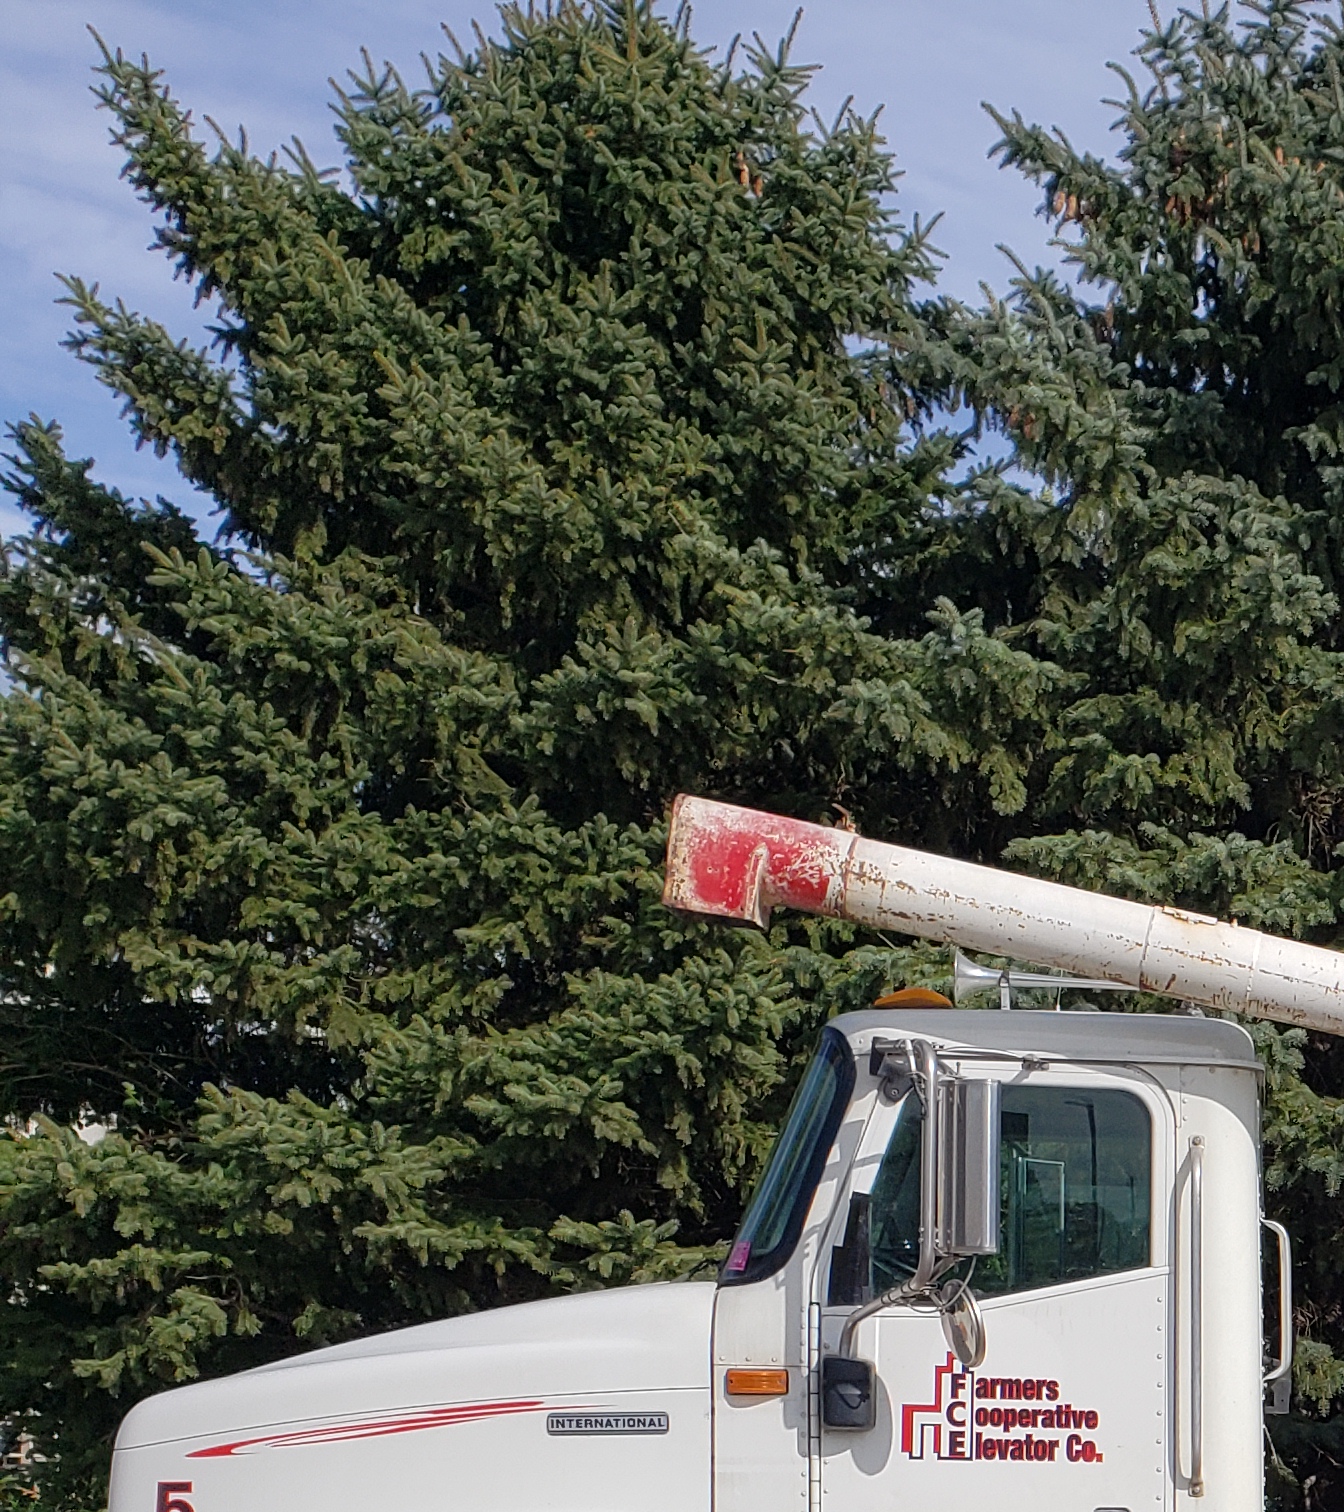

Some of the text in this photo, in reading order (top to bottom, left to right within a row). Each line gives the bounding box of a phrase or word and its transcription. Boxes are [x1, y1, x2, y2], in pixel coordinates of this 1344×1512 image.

[950, 1373, 1060, 1401] Farmers
[550, 1417, 666, 1429] INTERNATIONAL
[945, 1401, 1099, 1433] Cooperative
[948, 1430, 1104, 1463] Elevator Co.
